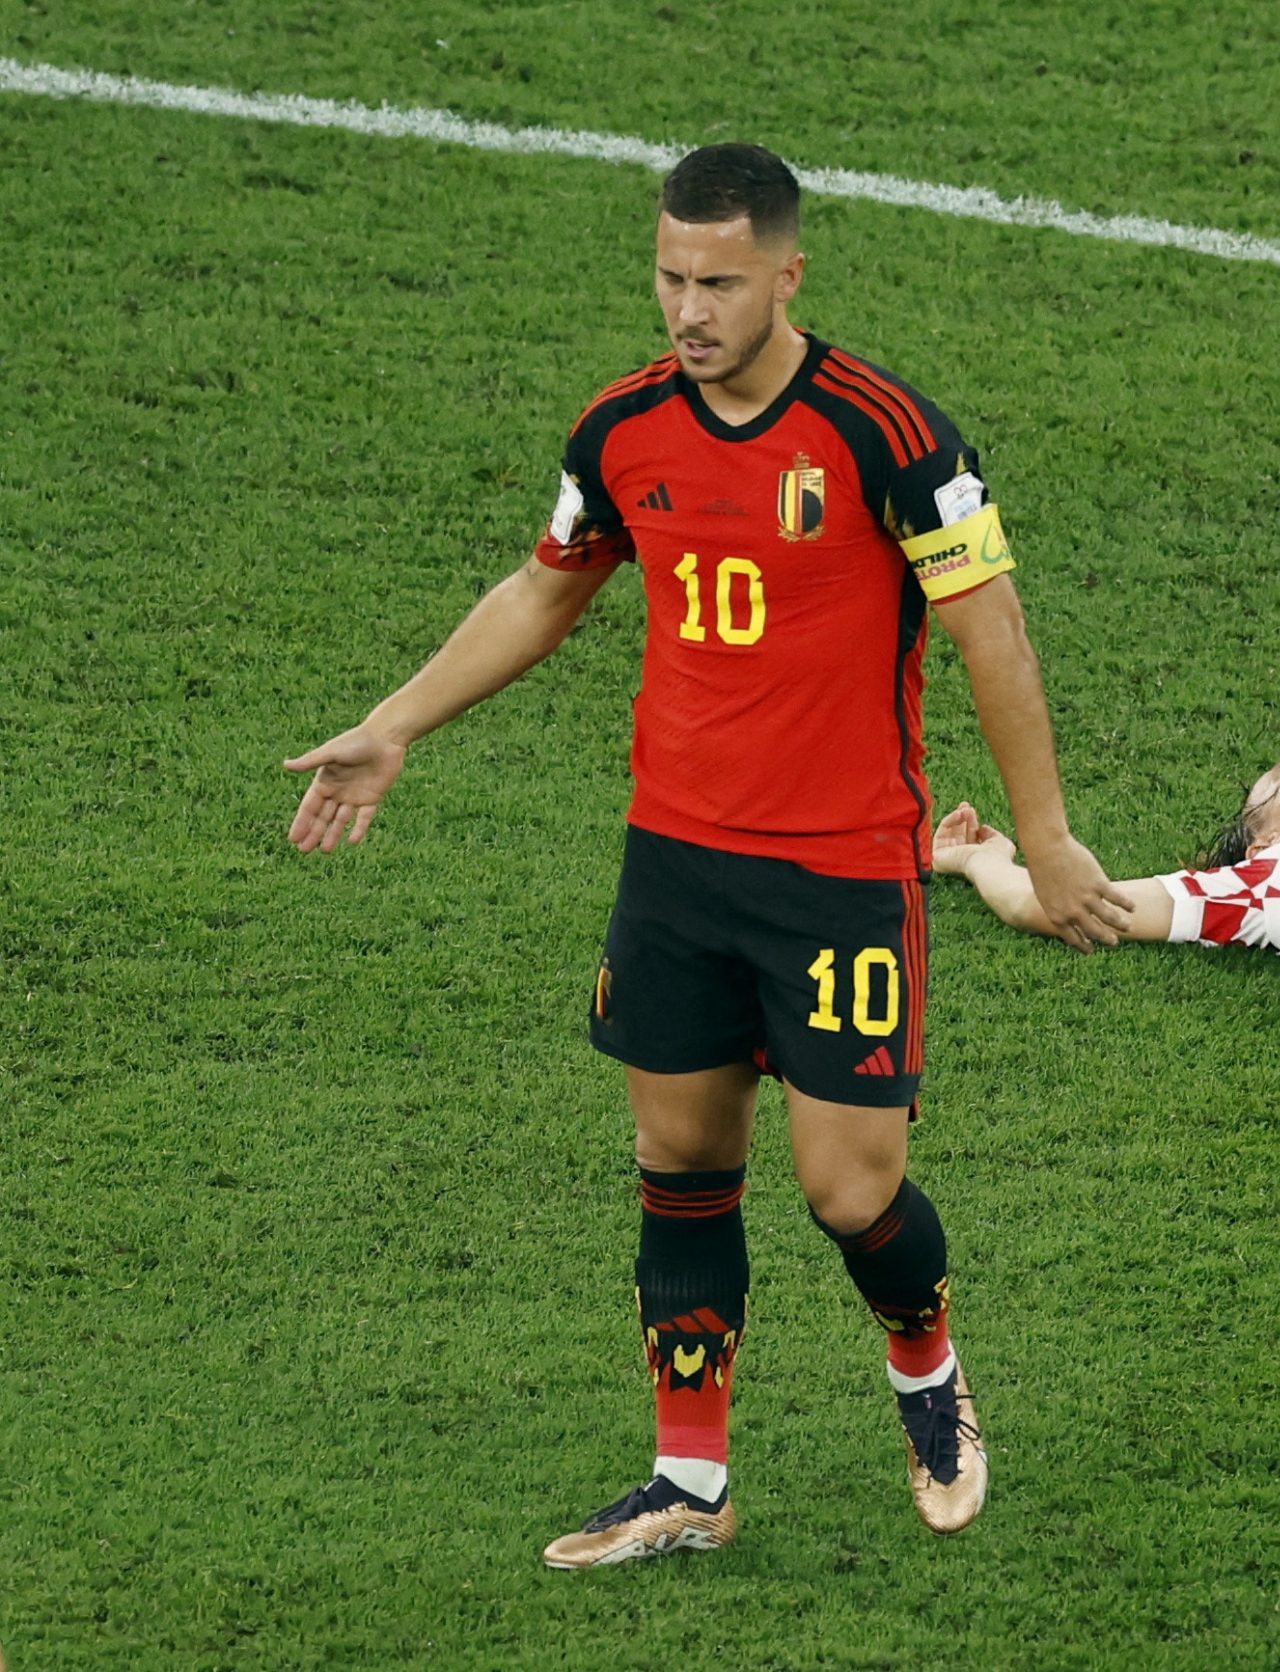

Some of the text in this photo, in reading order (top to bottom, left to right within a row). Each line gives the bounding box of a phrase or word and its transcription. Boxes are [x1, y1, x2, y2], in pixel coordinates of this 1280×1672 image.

[911, 543, 968, 568] CHILD
[914, 554, 971, 581] PROT
[674, 553, 767, 645] 10
[807, 947, 900, 1037] 10
